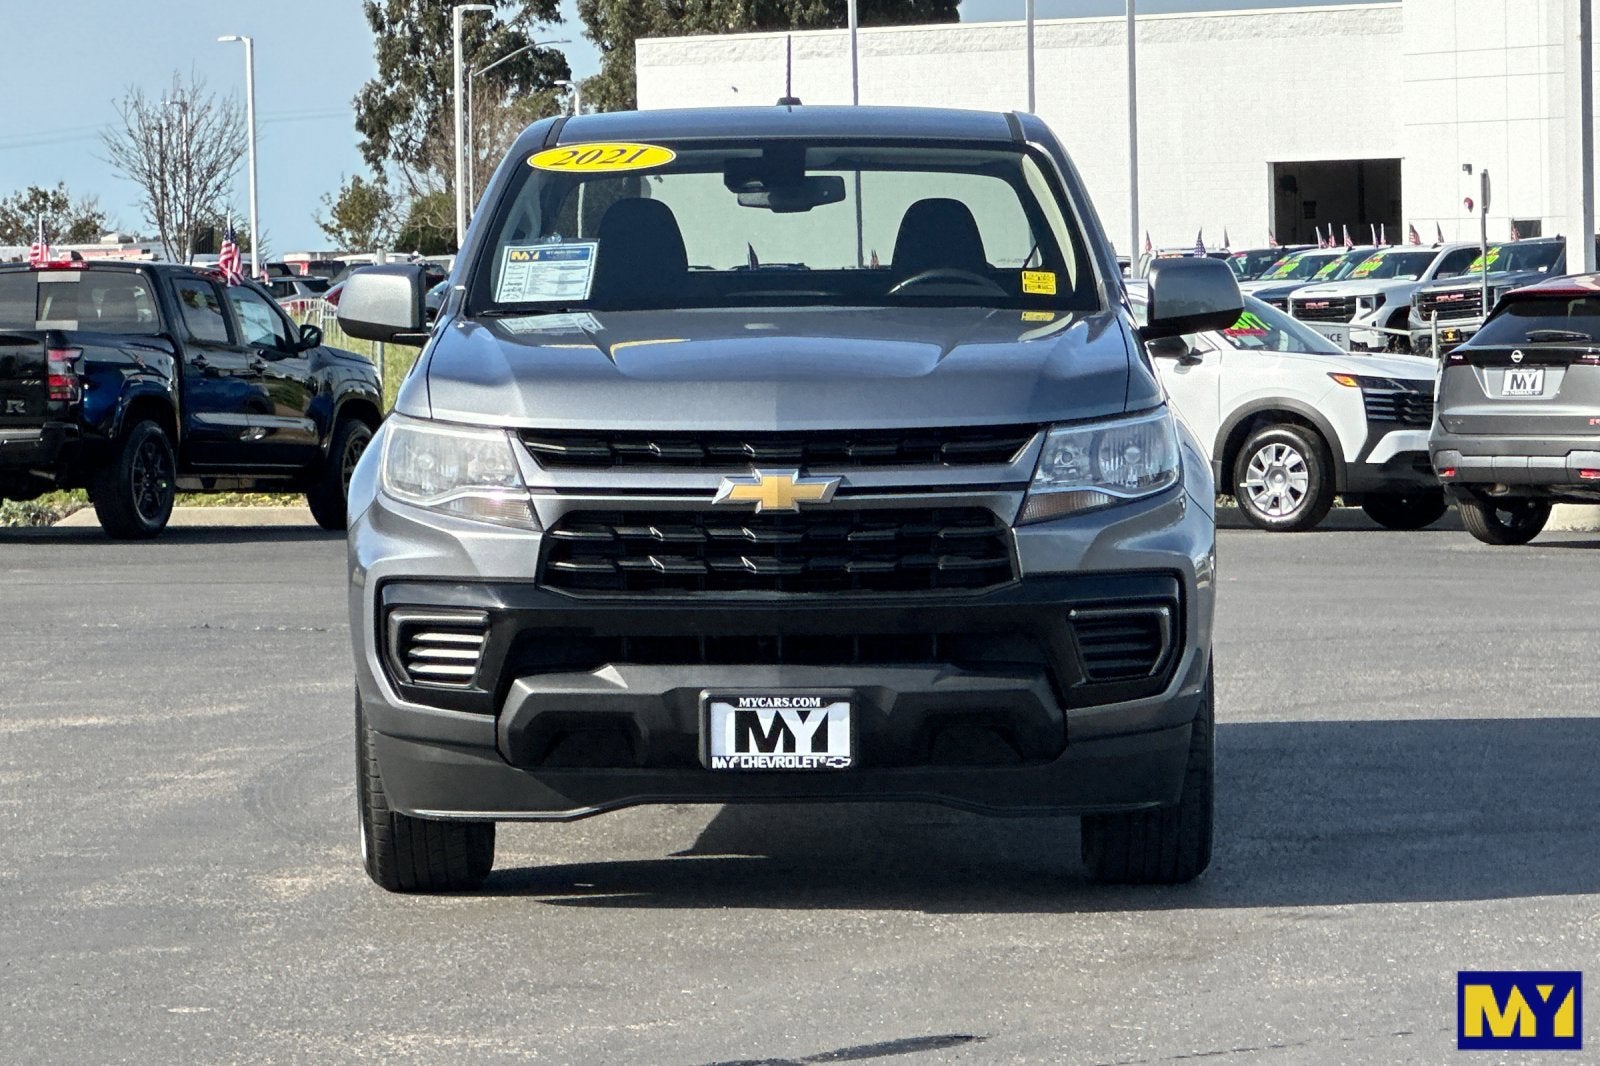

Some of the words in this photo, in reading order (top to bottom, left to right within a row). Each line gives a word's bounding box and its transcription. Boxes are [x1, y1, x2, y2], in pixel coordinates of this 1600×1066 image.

[550, 148, 649, 166] 2021
[1510, 373, 1538, 390] MY
[738, 697, 821, 708] MYCARS.COM
[734, 710, 829, 753] MY
[740, 757, 818, 769] CHEVROLET
